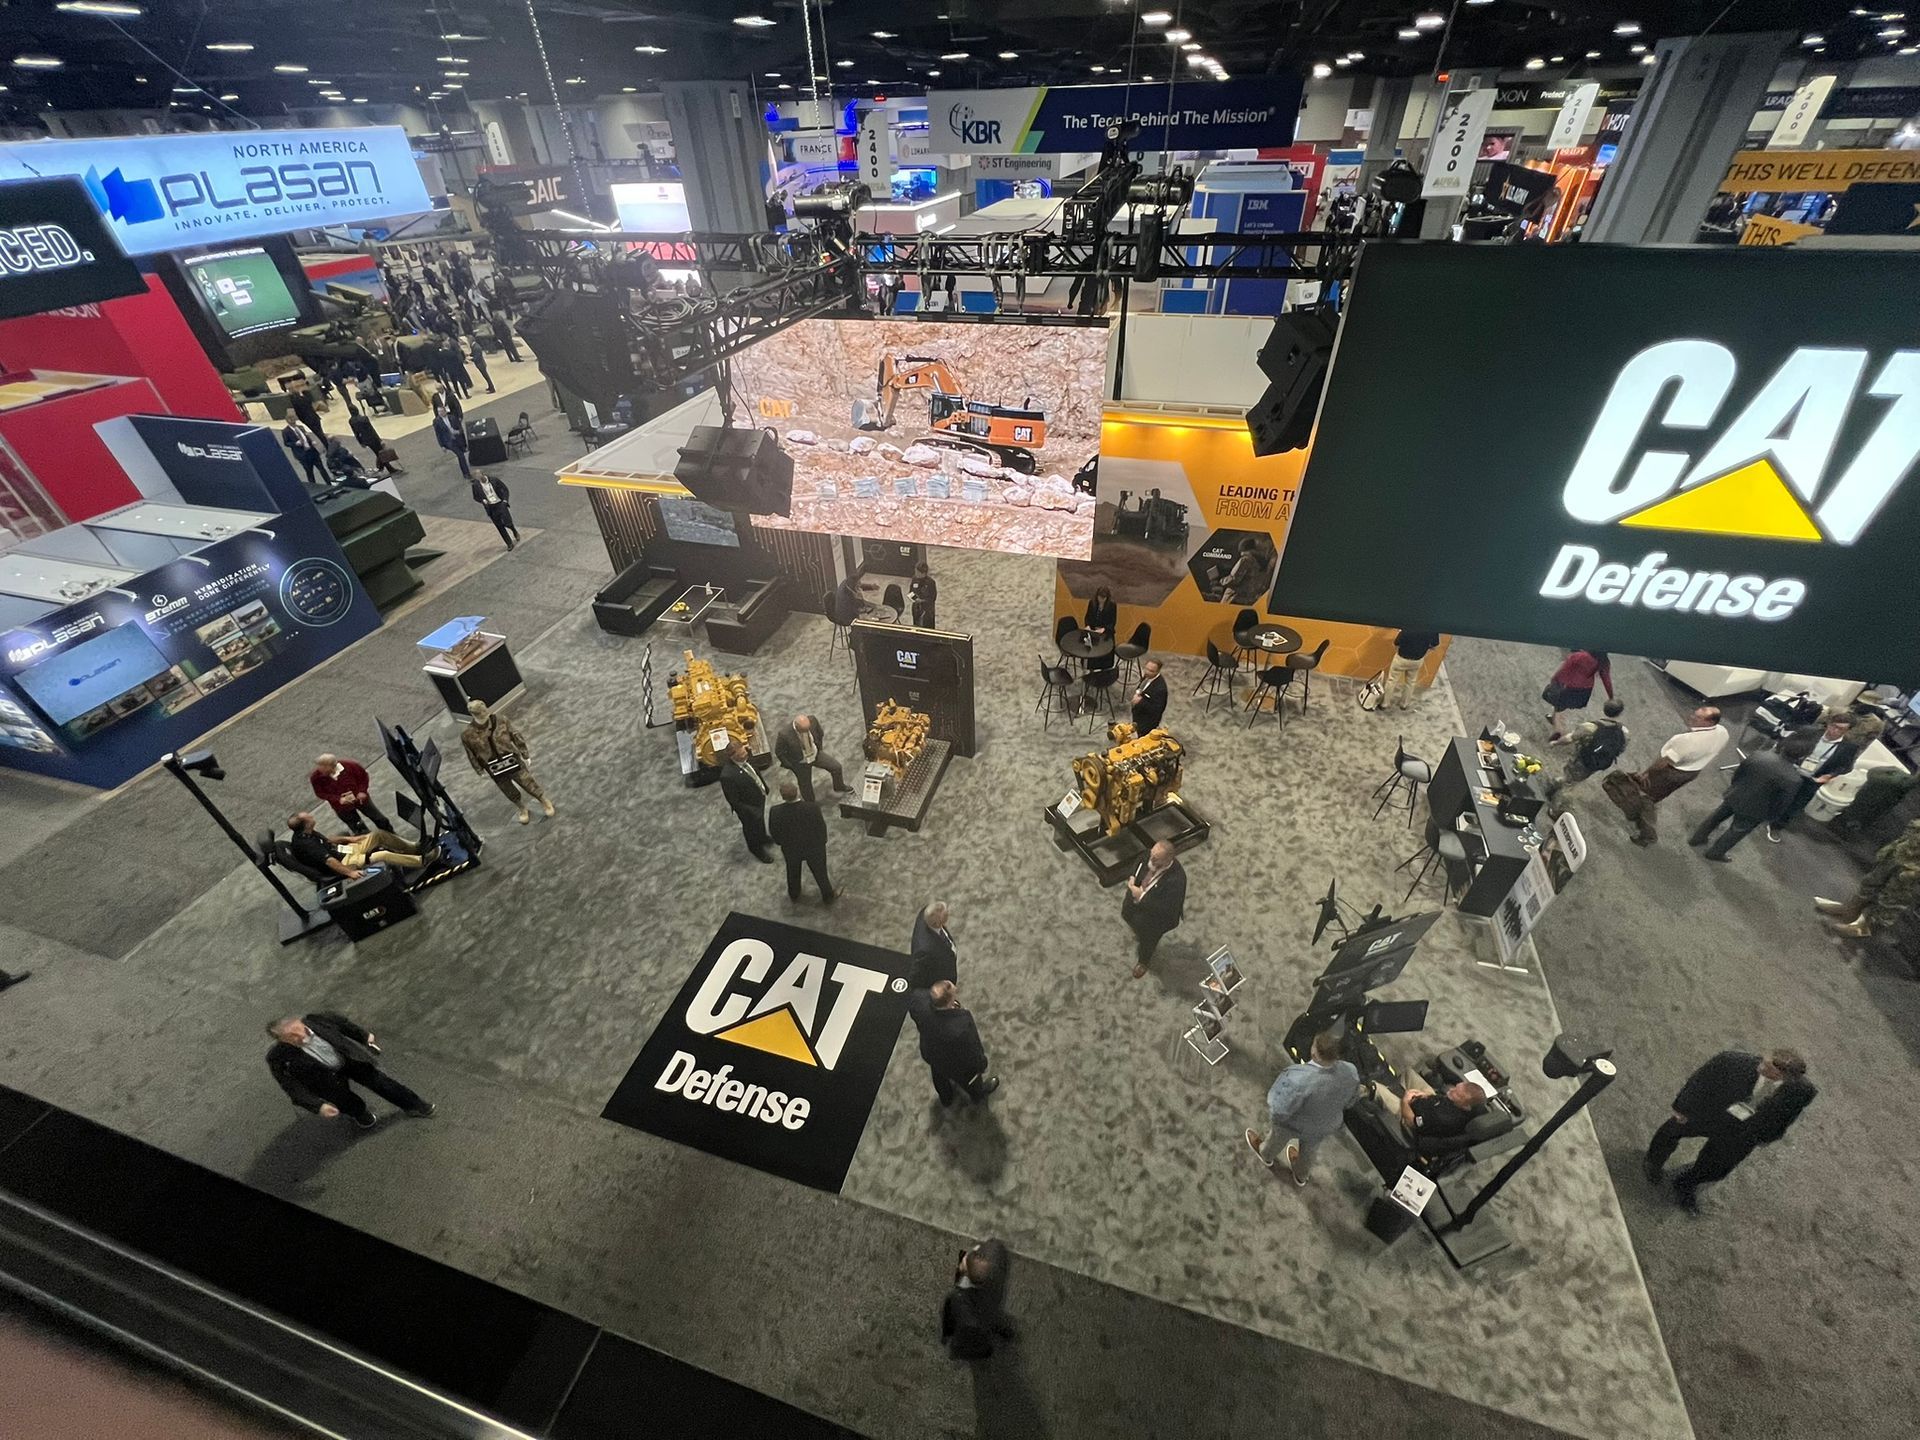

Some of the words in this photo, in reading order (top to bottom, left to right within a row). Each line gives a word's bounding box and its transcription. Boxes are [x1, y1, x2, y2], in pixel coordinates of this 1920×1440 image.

[1063, 115, 1088, 128] The
[1184, 110, 1209, 125] The
[1565, 99, 1582, 135] 2100
[962, 120, 1002, 144] KBR
[1446, 114, 1471, 172] 2200
[233, 143, 293, 159] NORTH
[299, 140, 368, 155] AMERICA
[800, 144, 832, 153] FRANCE
[868, 129, 879, 178] 2400
[992, 158, 1002, 168] ST
[1005, 157, 1051, 171] Engineering
[1778, 162, 1837, 180] WE'LL
[175, 210, 257, 231] INNOVATE.
[265, 202, 326, 217] DELIVER.
[333, 196, 391, 208] PROTECT.
[1247, 199, 1269, 211] IBM
[1744, 222, 1781, 246] THIS
[0, 224, 96, 276] CED.
[1014, 426, 1032, 442] CAT
[1563, 338, 1920, 546] CAT
[1219, 484, 1278, 501] LEADING
[1215, 498, 1273, 519] FROM
[193, 563, 258, 596] HYBRIDIZATION
[198, 589, 221, 601] DONE
[222, 563, 271, 590] DIFFERENTLY
[1539, 543, 1806, 622] Defense
[896, 650, 919, 664] CAT
[363, 907, 380, 920] CAT
[1367, 931, 1403, 952] CAT
[654, 1049, 811, 1130] Defense
